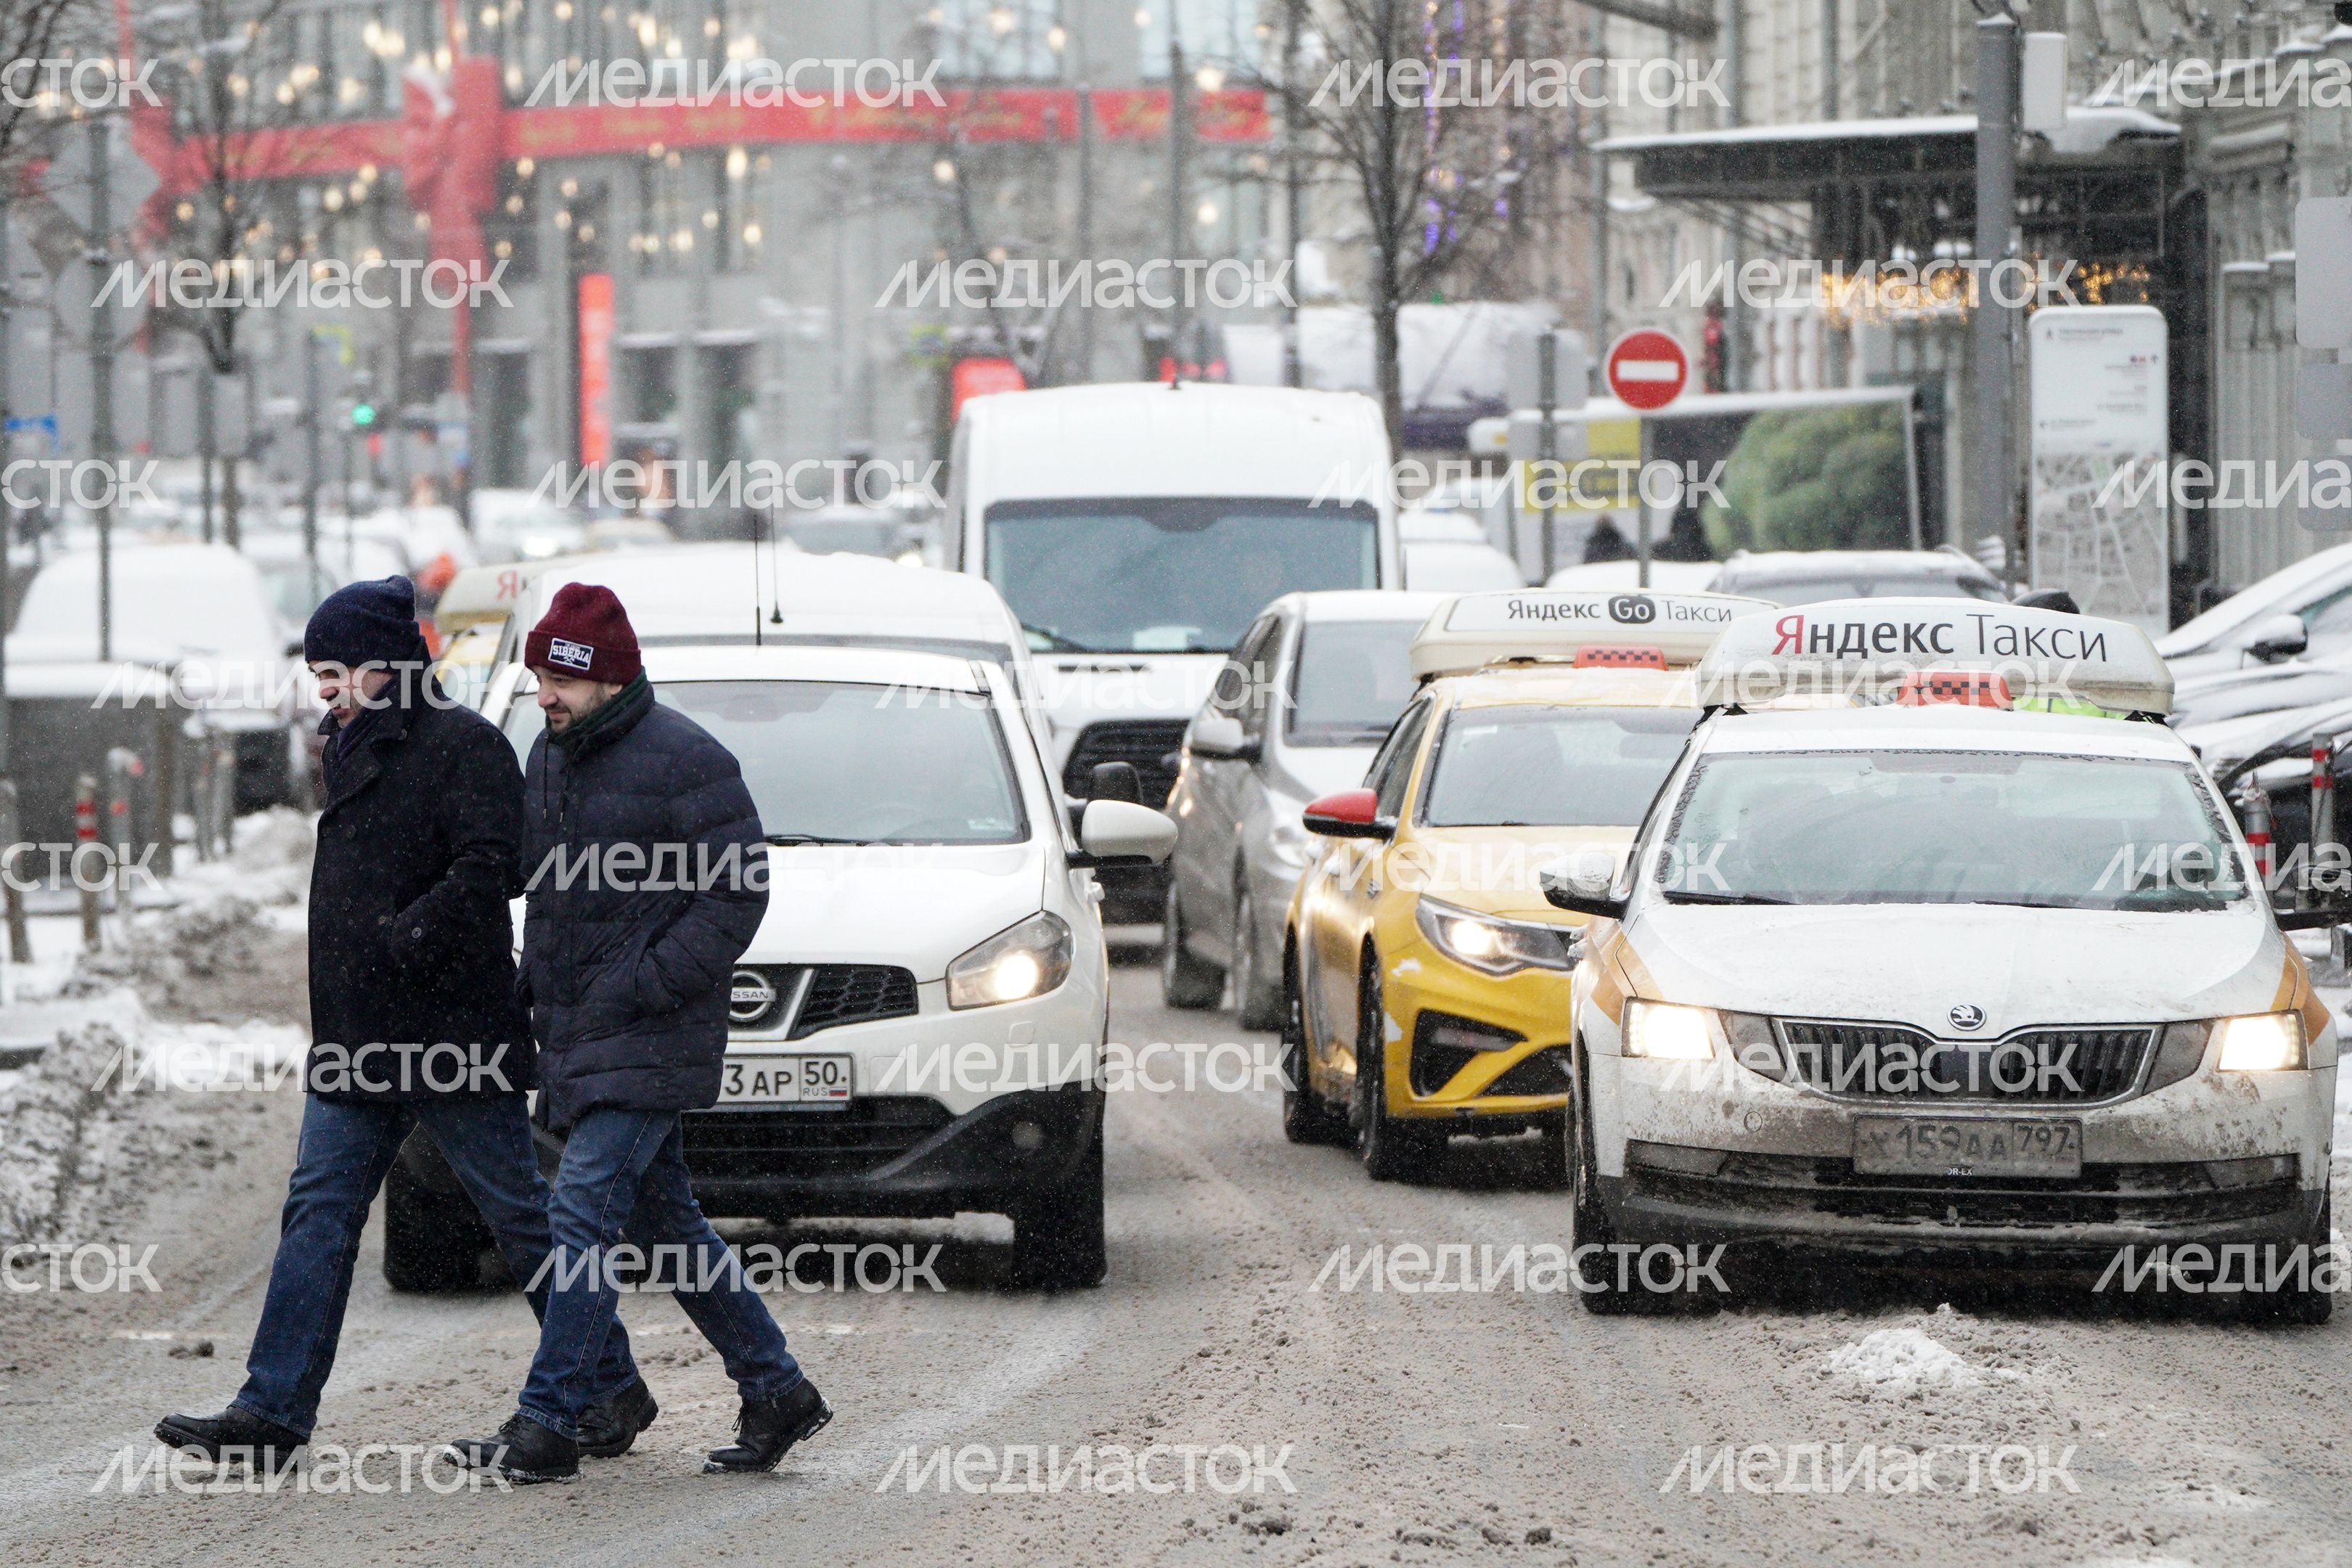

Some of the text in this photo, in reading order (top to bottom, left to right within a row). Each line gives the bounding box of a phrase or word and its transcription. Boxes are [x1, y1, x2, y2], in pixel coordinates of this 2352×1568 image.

[1508, 599, 1732, 622] Яндекс Go Такси
[1771, 614, 2107, 662] Яндекс Такси
[552, 645, 589, 663] SIBERIA
